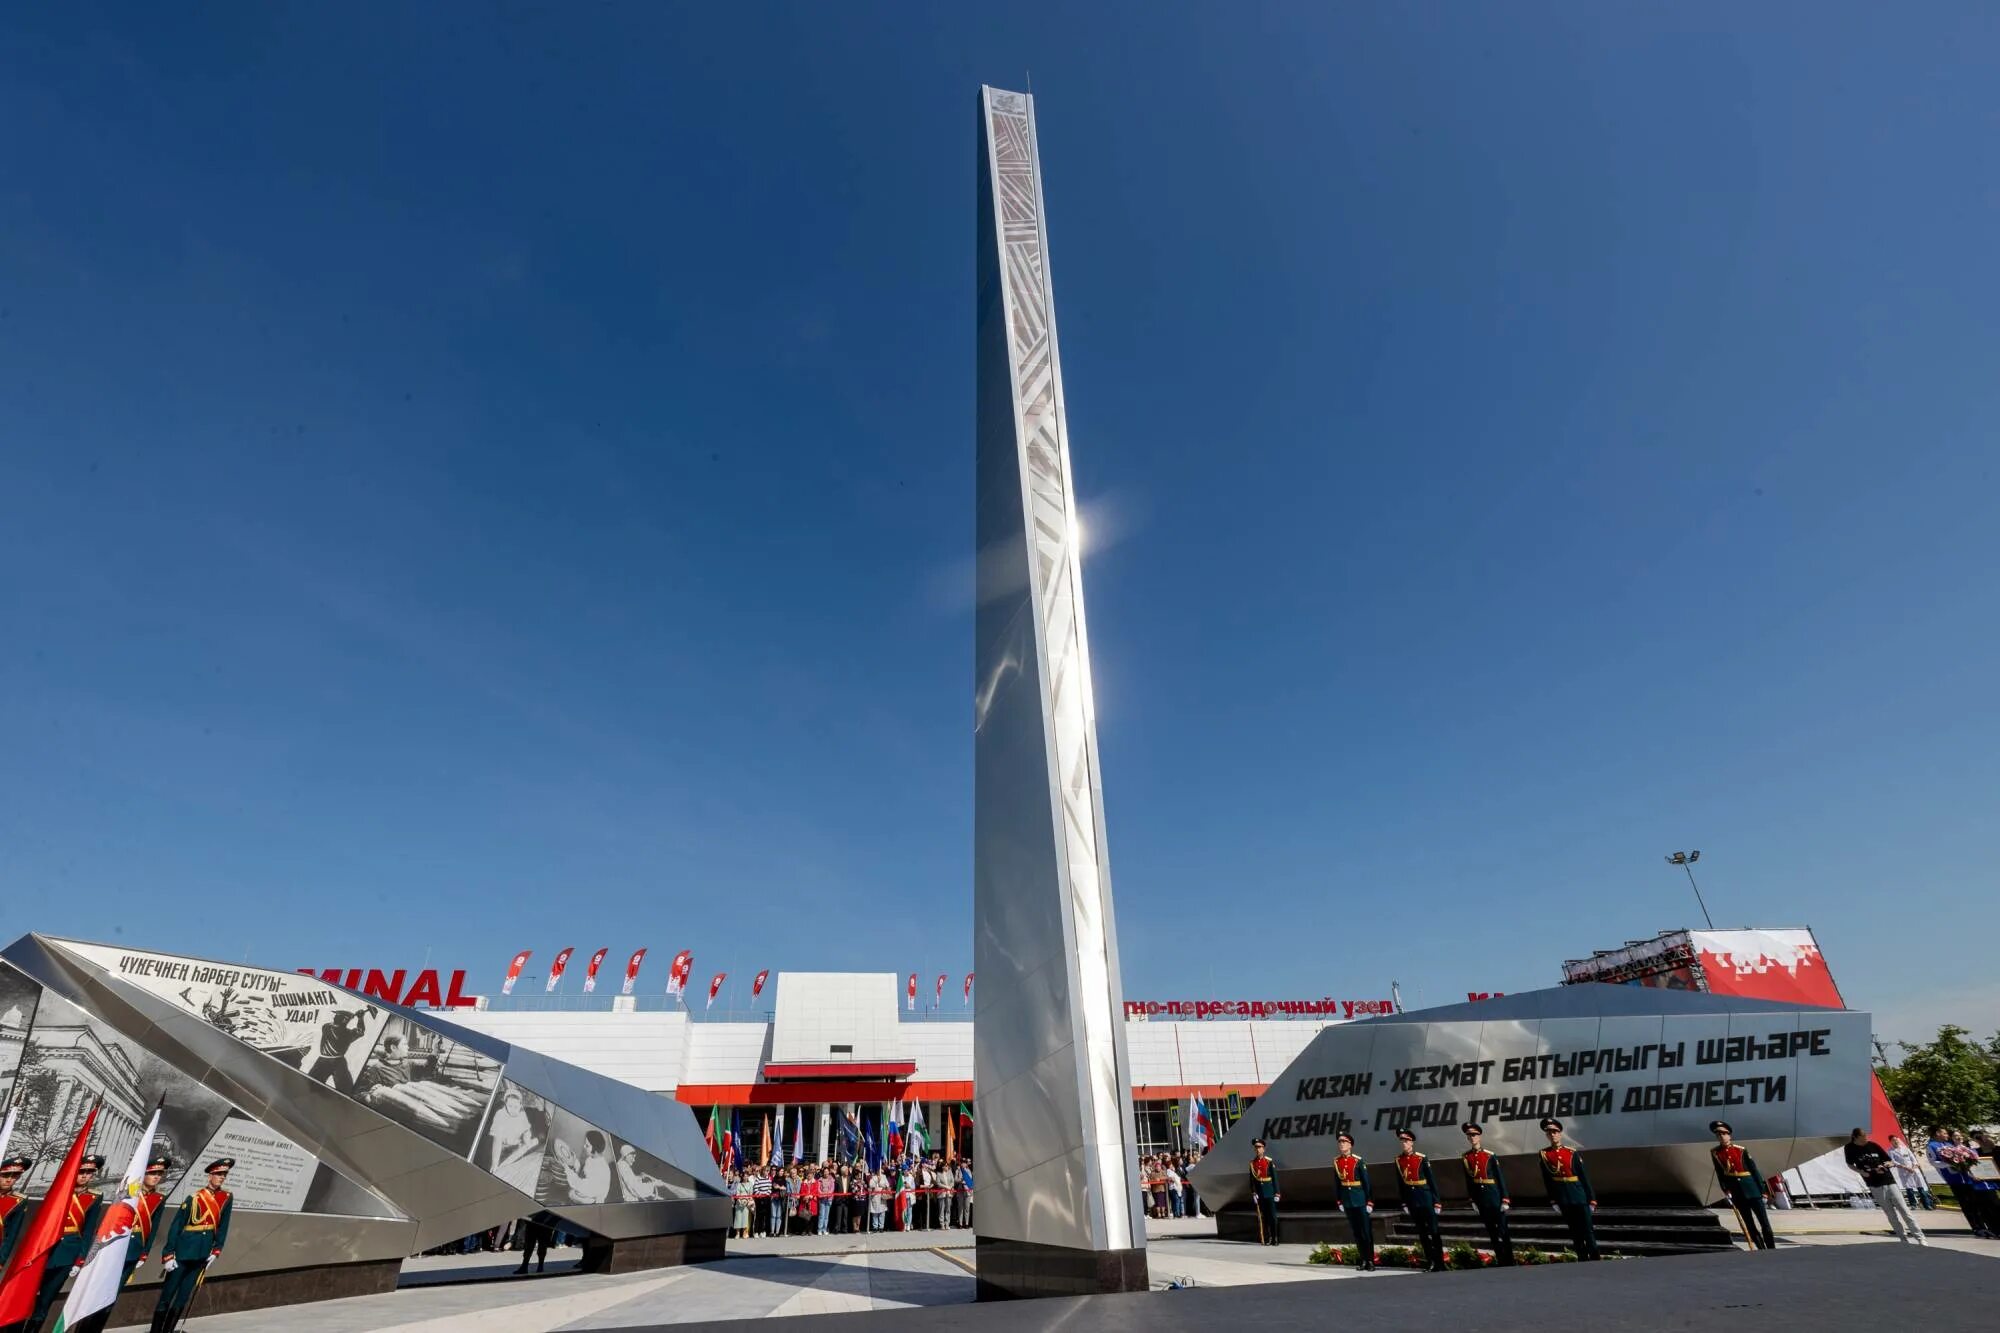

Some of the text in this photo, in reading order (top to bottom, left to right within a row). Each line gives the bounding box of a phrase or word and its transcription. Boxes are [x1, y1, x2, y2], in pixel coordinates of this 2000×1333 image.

[284, 1009, 320, 1024] УДАР!
[1341, 1001, 1394, 1019] узел
[1295, 1072, 1373, 1101] КАЗАН
[1502, 1042, 1685, 1082] БАТЫРЛЫГЫ
[1261, 1112, 1352, 1140] КАЗАНЬ
[1374, 1102, 1459, 1132] ГОРОД
[1468, 1083, 1614, 1124] ТРУДОВОЙ
[1621, 1075, 1787, 1113] ДОБЛЕСТИ
